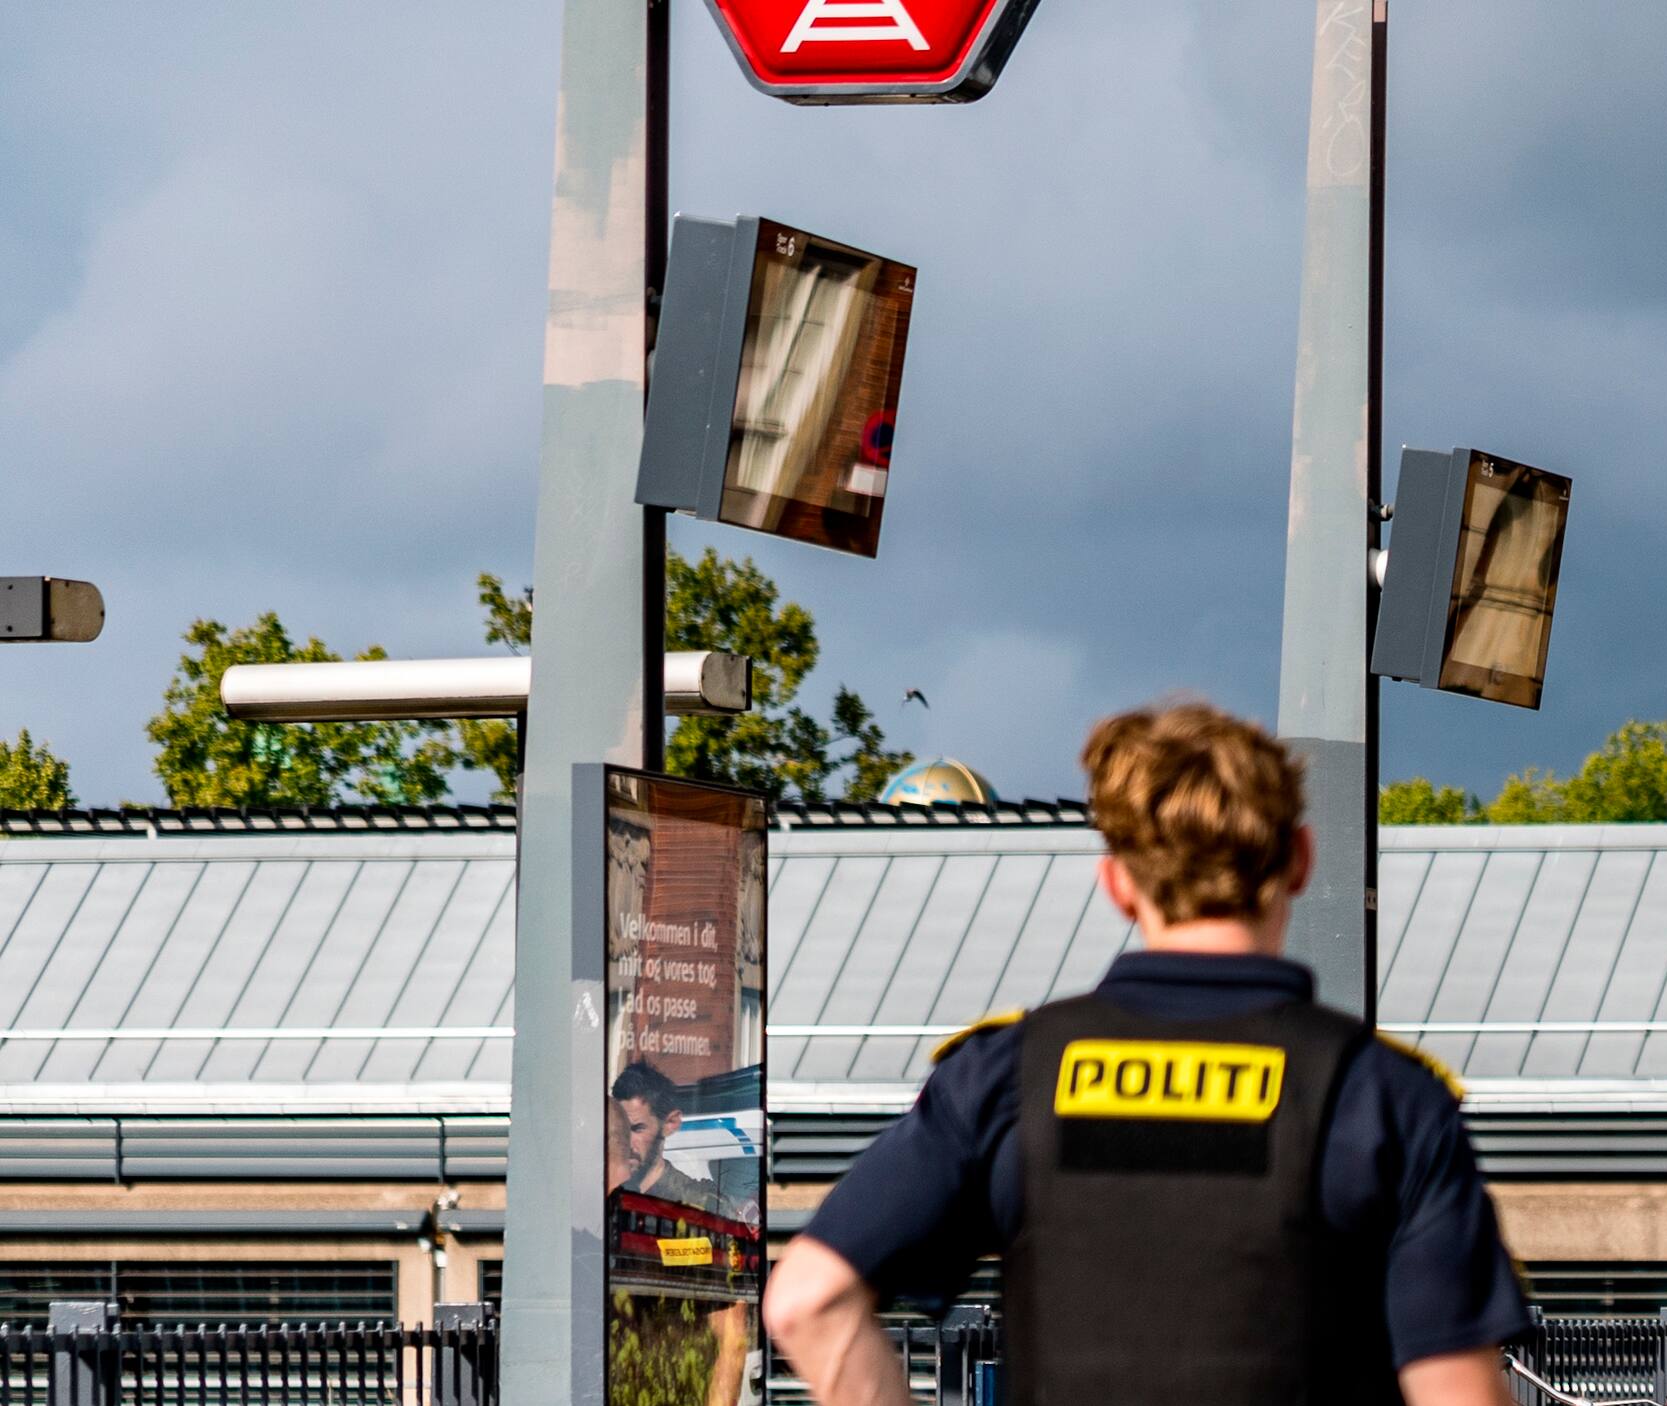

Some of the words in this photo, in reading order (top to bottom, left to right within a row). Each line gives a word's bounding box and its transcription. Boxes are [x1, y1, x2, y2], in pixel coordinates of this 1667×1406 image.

[620, 913, 691, 946] Velkommen
[694, 921, 698, 946] i
[619, 949, 642, 977] mit
[646, 957, 662, 984] og
[664, 960, 695, 983] vores
[619, 987, 644, 1014] Lad
[647, 995, 661, 1016] os
[663, 996, 697, 1022] passe
[619, 1022, 635, 1055] på
[640, 1025, 660, 1053] det
[1069, 1058, 1271, 1103] POLITI
